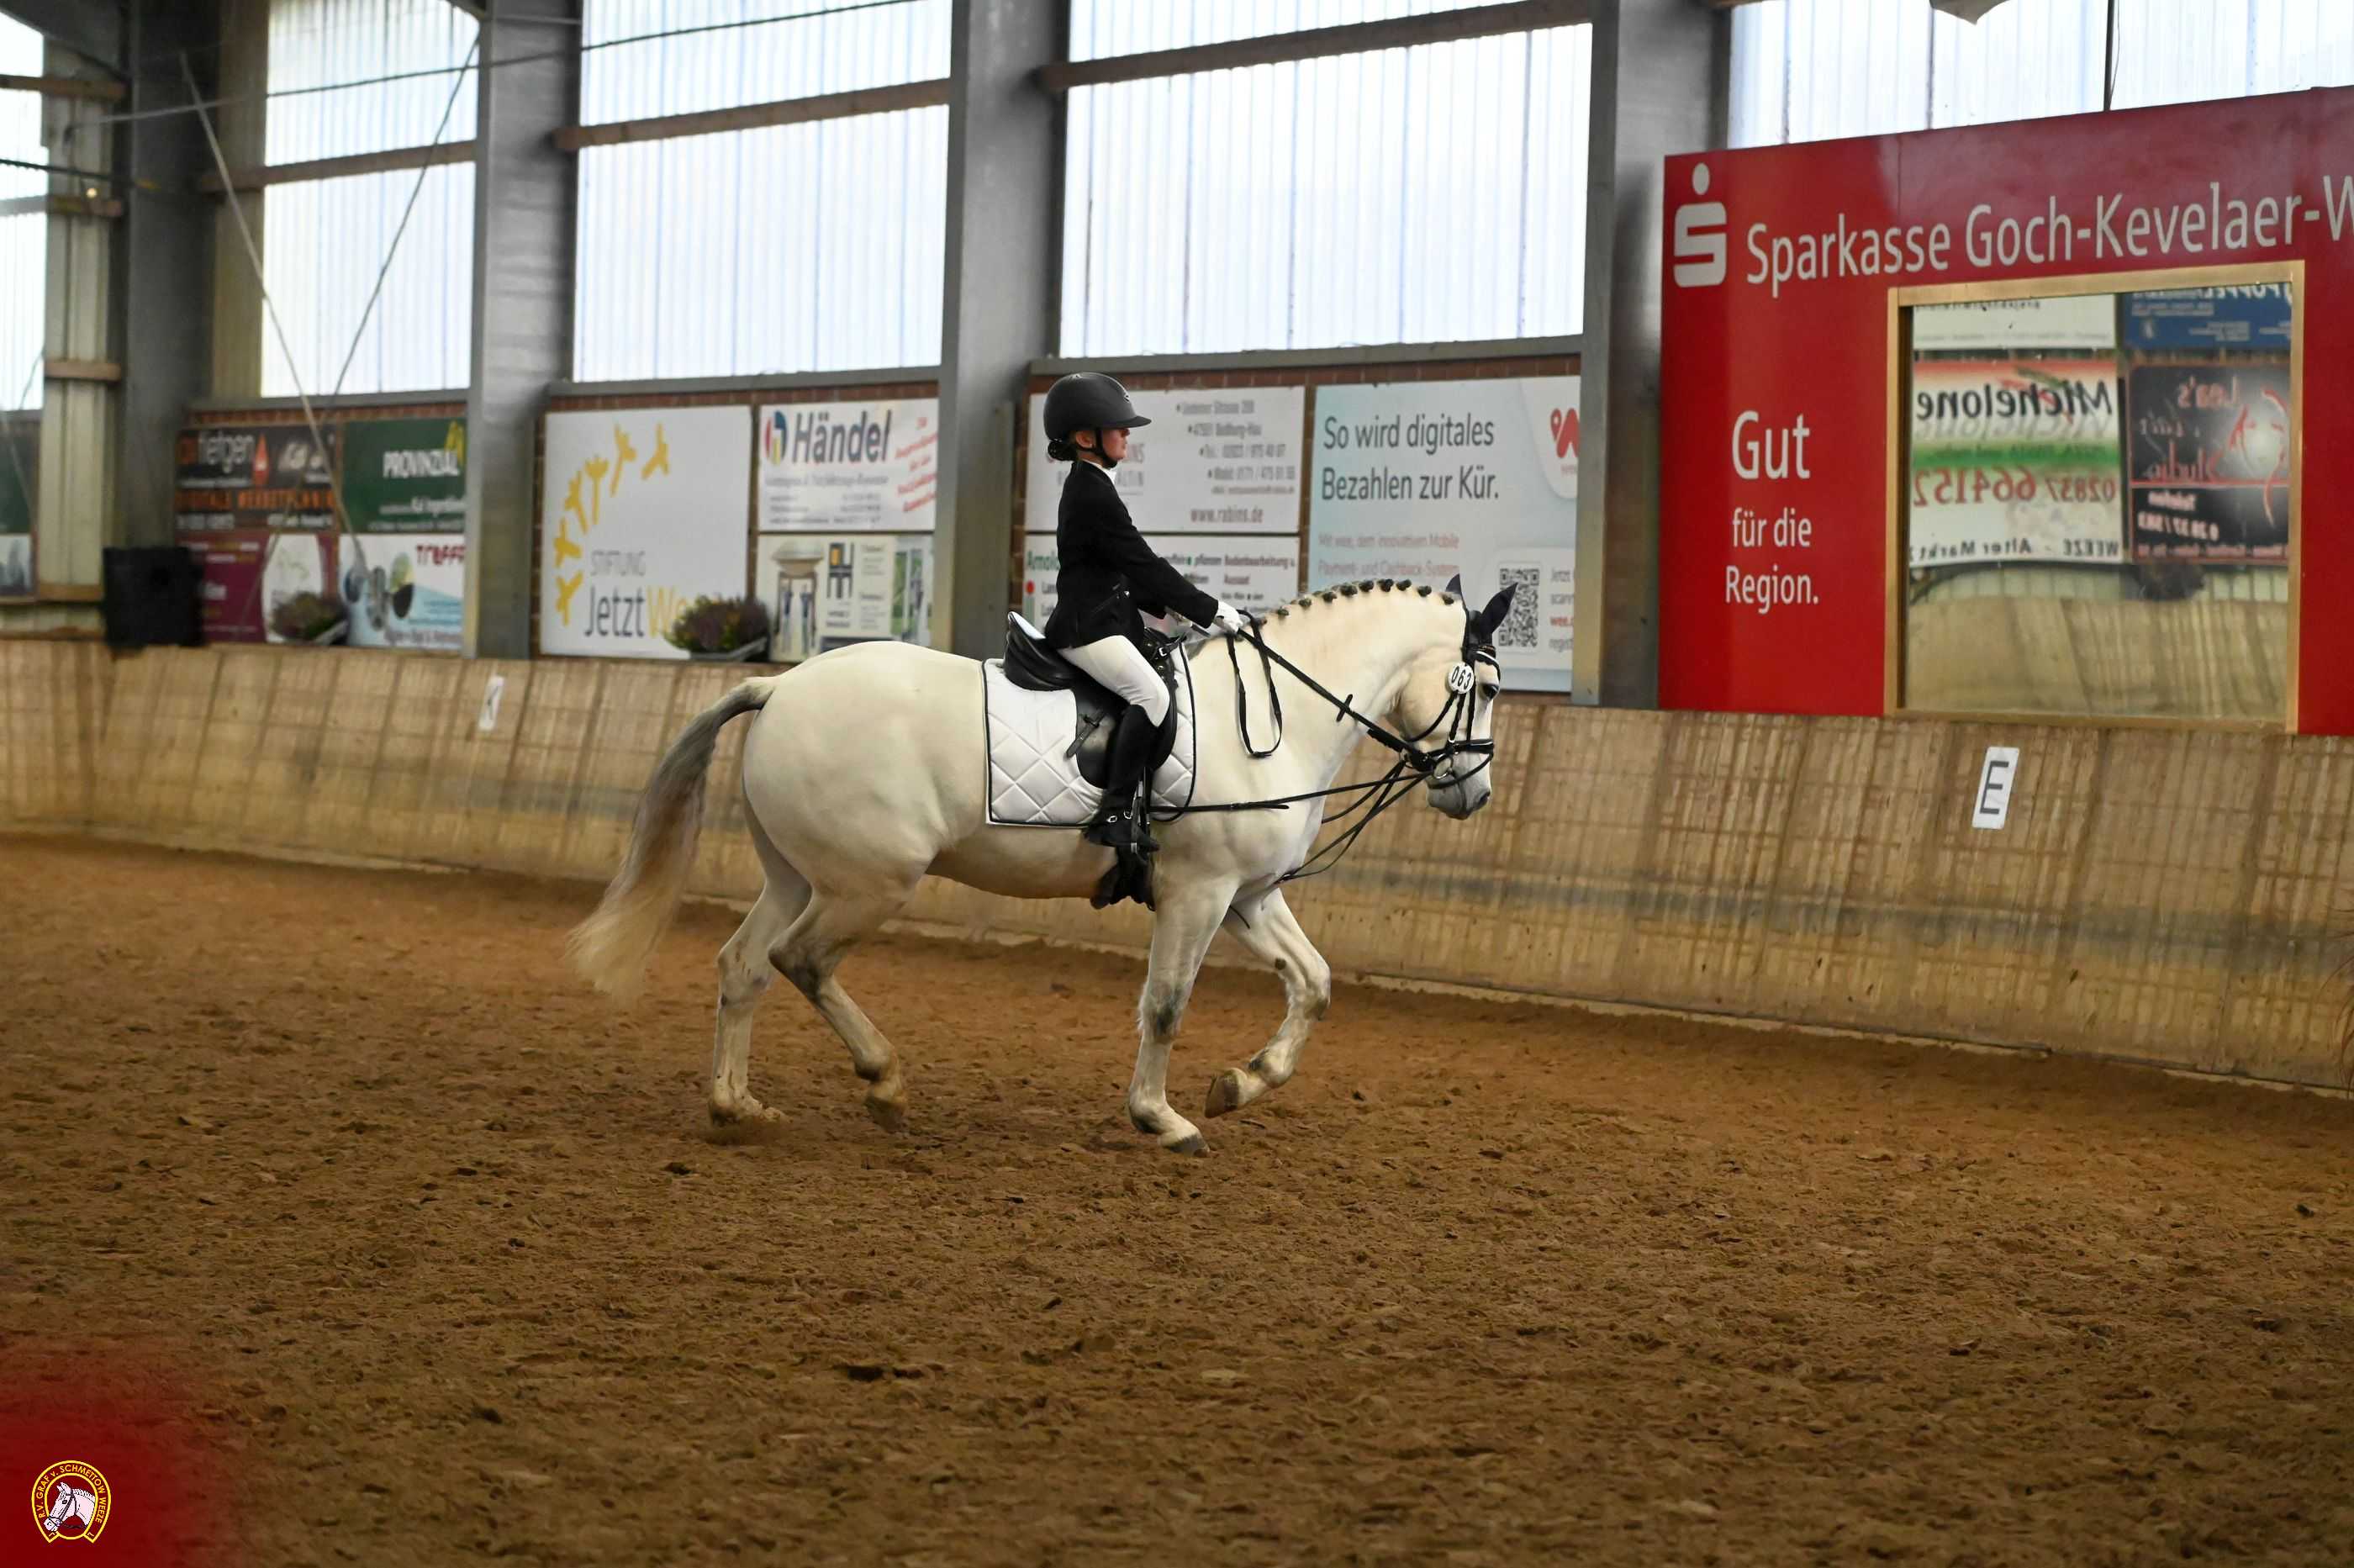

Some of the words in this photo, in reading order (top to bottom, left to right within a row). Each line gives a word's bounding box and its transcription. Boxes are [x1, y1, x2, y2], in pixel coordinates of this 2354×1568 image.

[1746, 213, 1951, 298] Sparkasse
[792, 409, 892, 463] Händel
[1323, 416, 1349, 449] So
[1355, 414, 1400, 448] wird
[1407, 412, 1495, 455] digitales
[1732, 410, 1811, 479] Gut
[383, 450, 460, 479] PROVINZIAL
[1322, 467, 1412, 500] Bezahlen
[1419, 475, 1453, 499] zur
[1459, 465, 1499, 500] Kür.
[1733, 507, 1766, 547] für
[1773, 507, 1812, 547] die
[590, 550, 645, 576] STIFTUNG
[1725, 564, 1819, 614] Region.
[1451, 666, 1472, 690] 063
[1980, 760, 2009, 815] E
